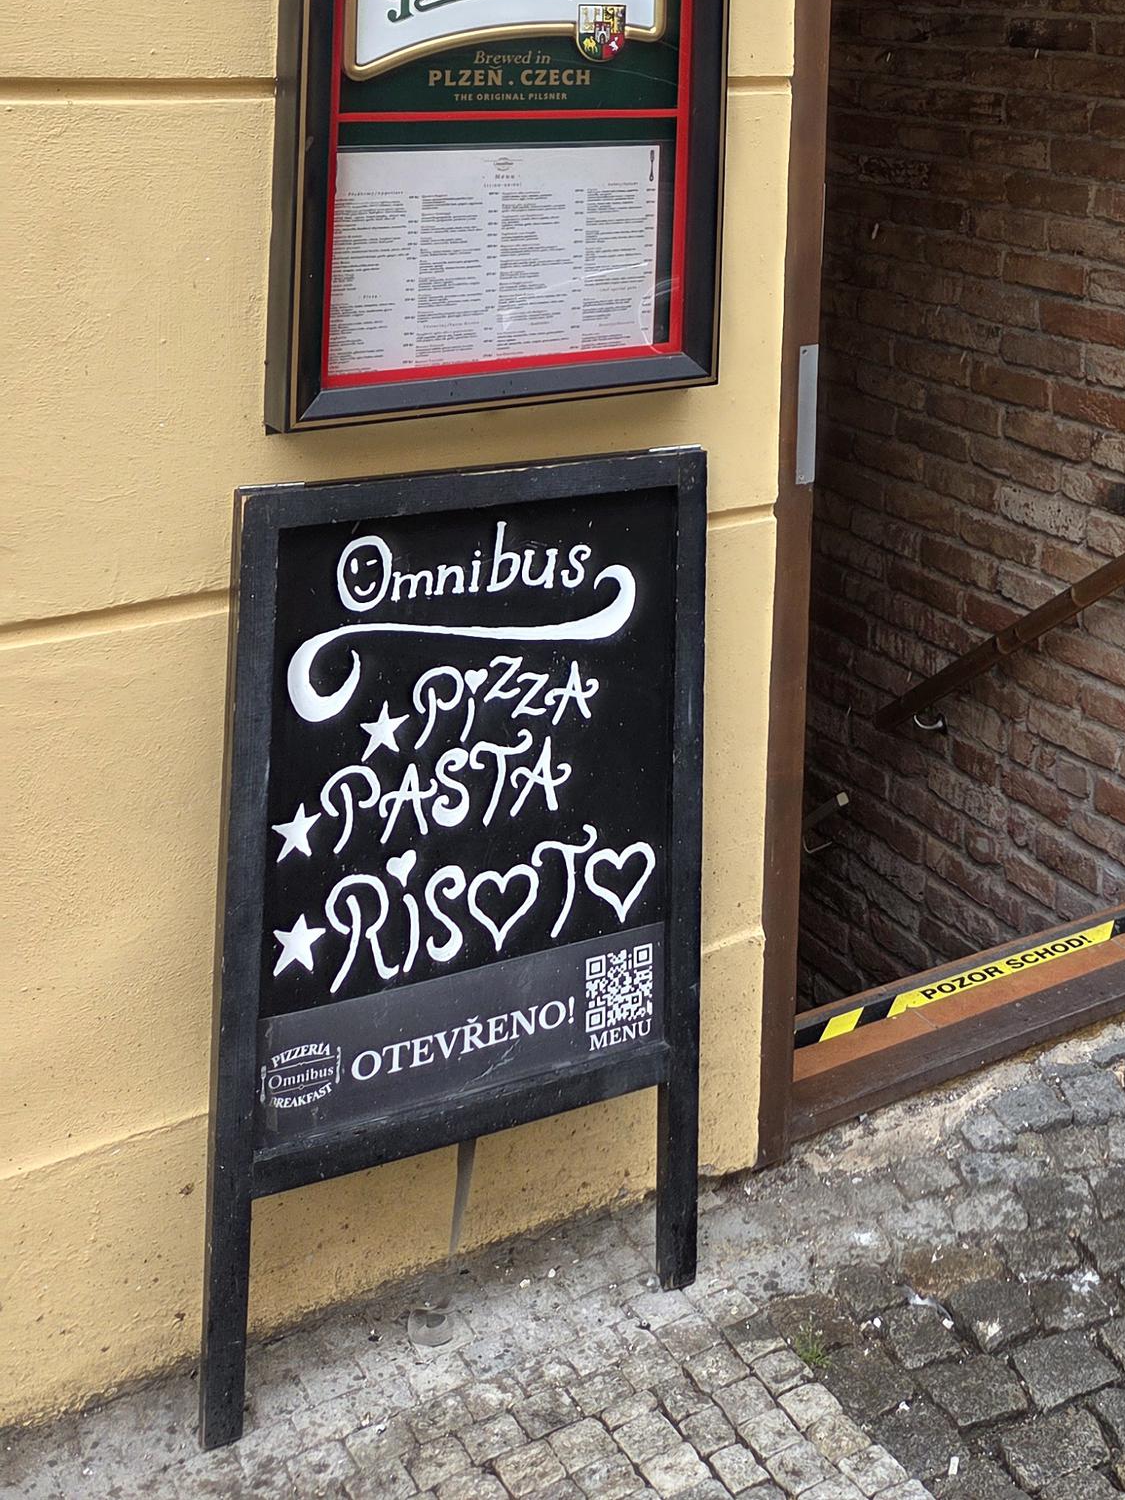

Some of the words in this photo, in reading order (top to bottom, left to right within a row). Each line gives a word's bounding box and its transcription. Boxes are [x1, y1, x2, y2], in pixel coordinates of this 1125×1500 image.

[474, 50, 533, 65] Brewed
[536, 51, 552, 65] in
[428, 65, 503, 87] PLZEŇ
[520, 69, 592, 86] CZECH
[454, 93, 473, 101] THE
[476, 92, 526, 101] ORIGINAL
[528, 92, 568, 101] PILSNER
[336, 521, 593, 613] Omnibus
[320, 729, 572, 854] PASTA
[920, 964, 1004, 1001] POZOR
[1005, 934, 1093, 971] SCHOD!
[350, 994, 576, 1083] OTEVŘENO!
[588, 1018, 653, 1052] MENU
[271, 1042, 331, 1068] PIZZERIA
[268, 1066, 334, 1090] Omnibus
